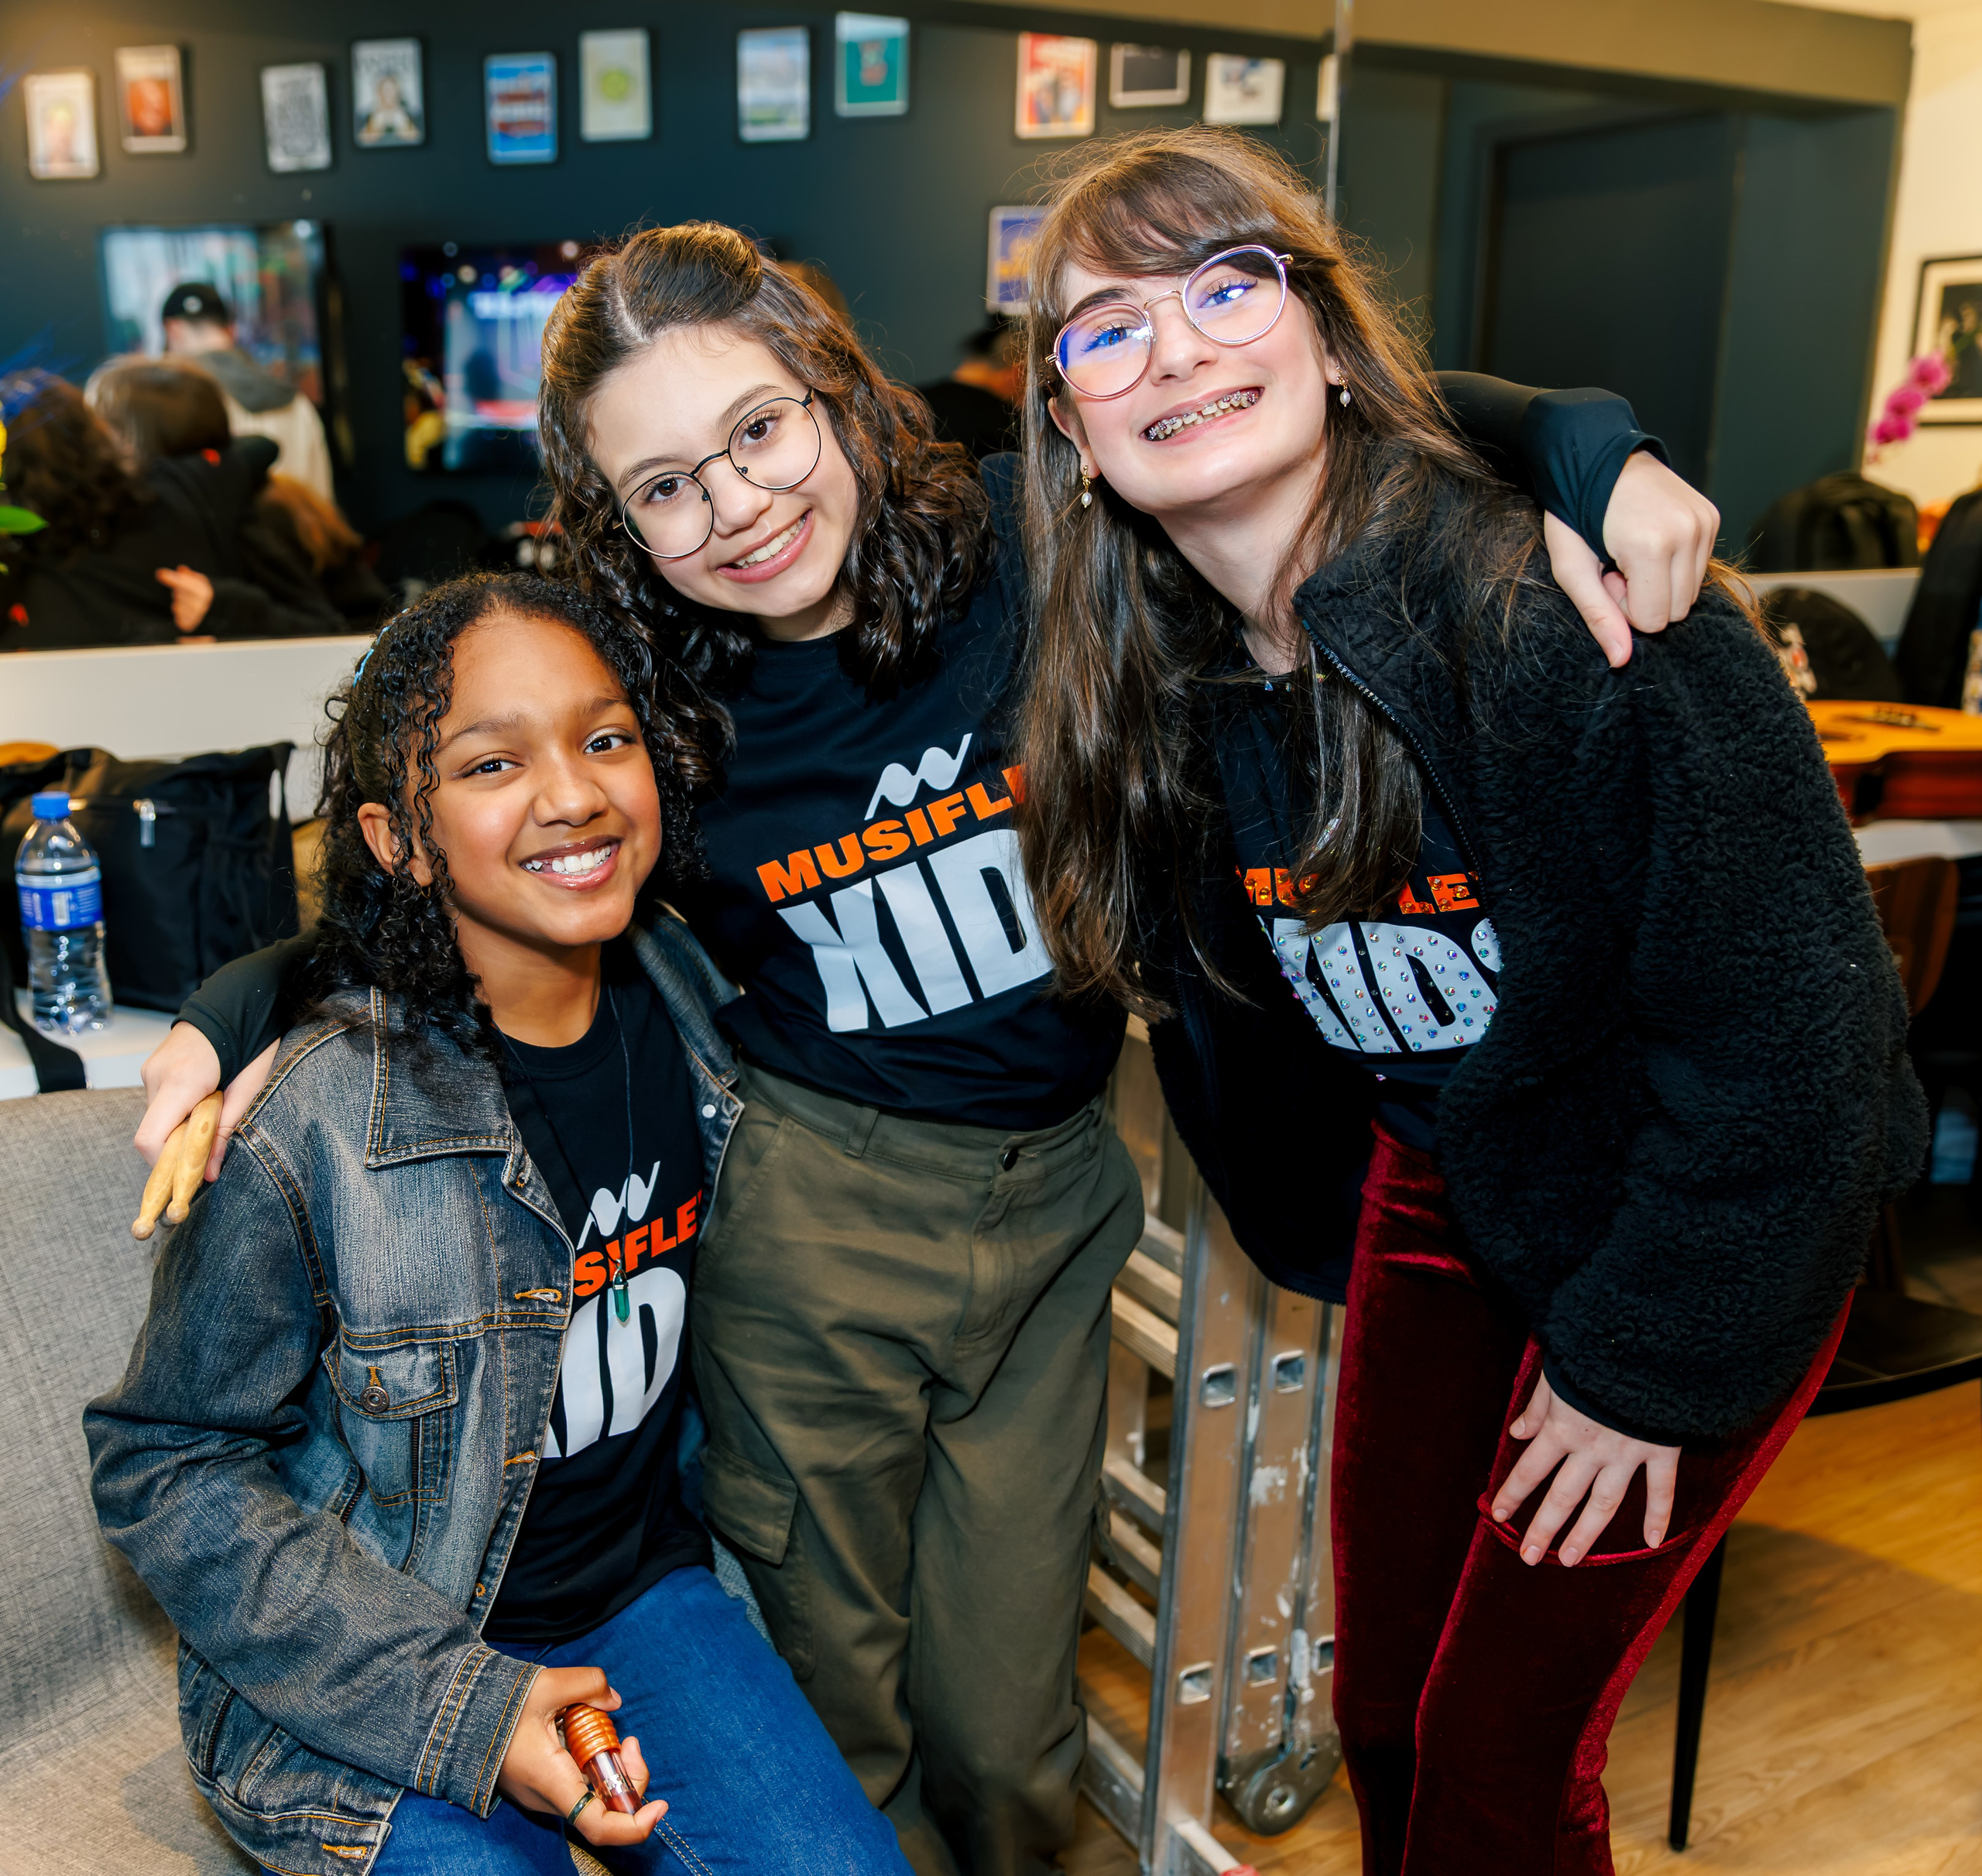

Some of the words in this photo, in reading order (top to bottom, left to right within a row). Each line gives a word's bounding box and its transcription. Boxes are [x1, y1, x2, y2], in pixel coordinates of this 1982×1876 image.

[756, 763, 1028, 902] MUSIFL
[777, 828, 1054, 1032] KID
[574, 1189, 702, 1297] SIFLE
